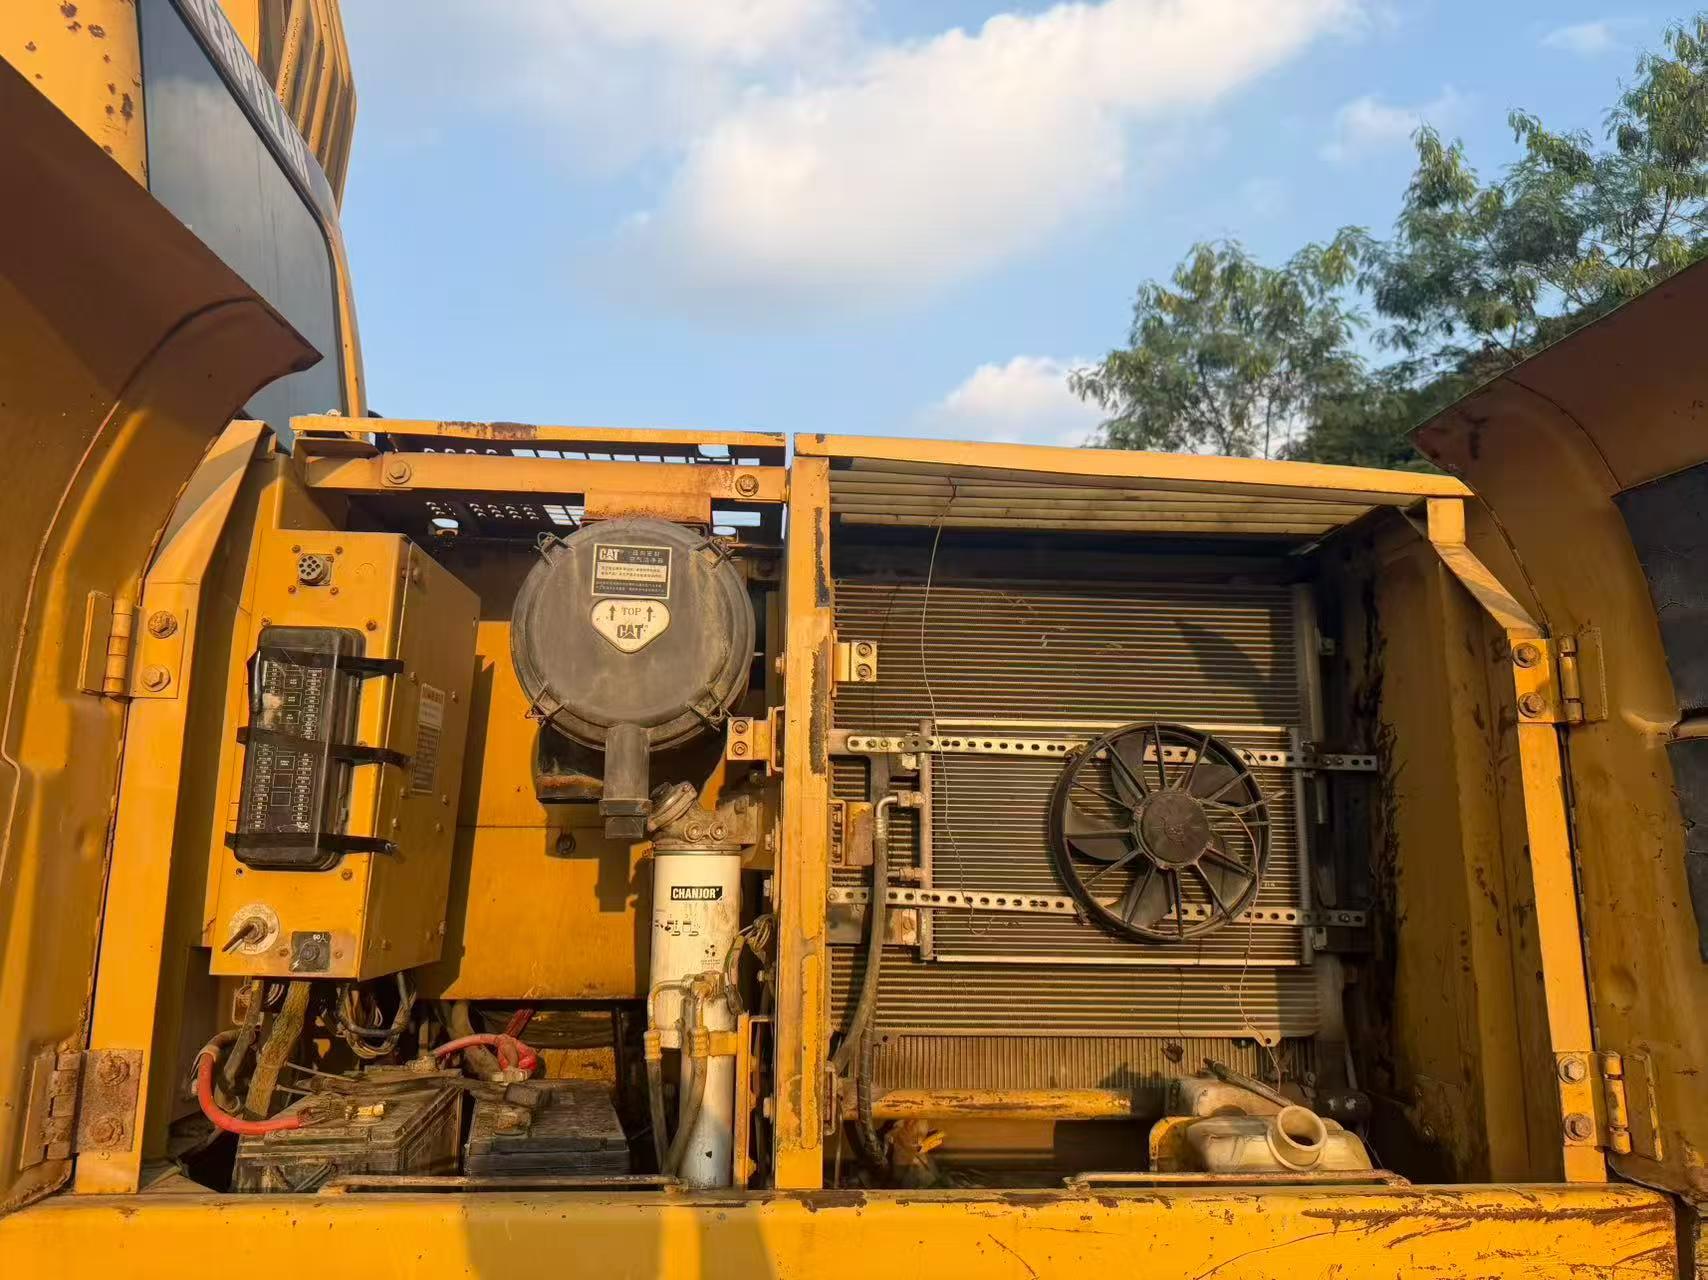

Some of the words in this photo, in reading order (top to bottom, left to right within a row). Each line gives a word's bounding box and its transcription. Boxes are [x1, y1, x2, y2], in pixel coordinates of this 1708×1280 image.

[599, 547, 620, 561] CAT
[621, 607, 642, 616] TOP
[616, 623, 644, 640] CAT
[672, 888, 716, 899] CHANJOR
